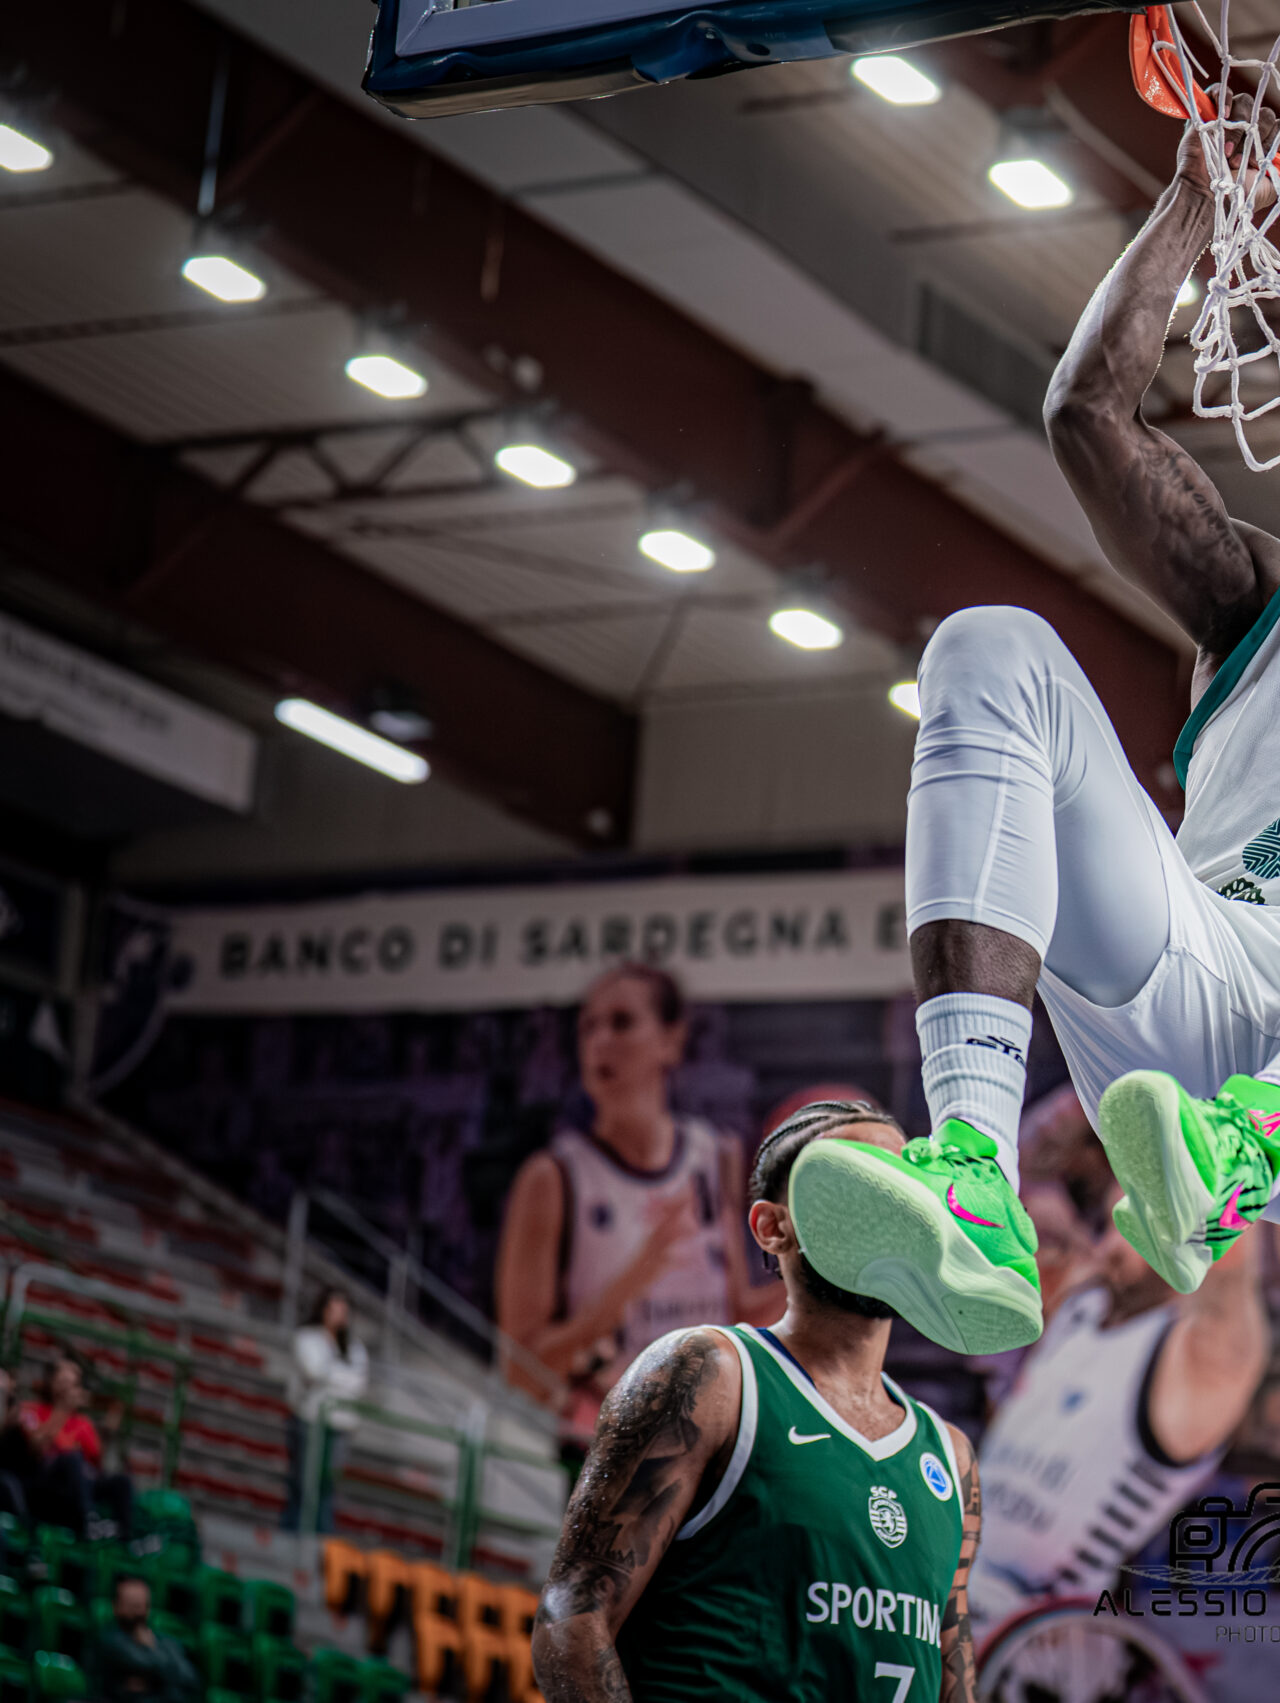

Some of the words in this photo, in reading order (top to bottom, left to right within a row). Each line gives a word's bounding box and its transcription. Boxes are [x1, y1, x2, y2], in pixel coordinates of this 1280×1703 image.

[219, 922, 417, 981] BANCO
[438, 918, 499, 972] DI
[520, 902, 850, 968] SARDEGNA
[874, 1661, 916, 1703] 7
